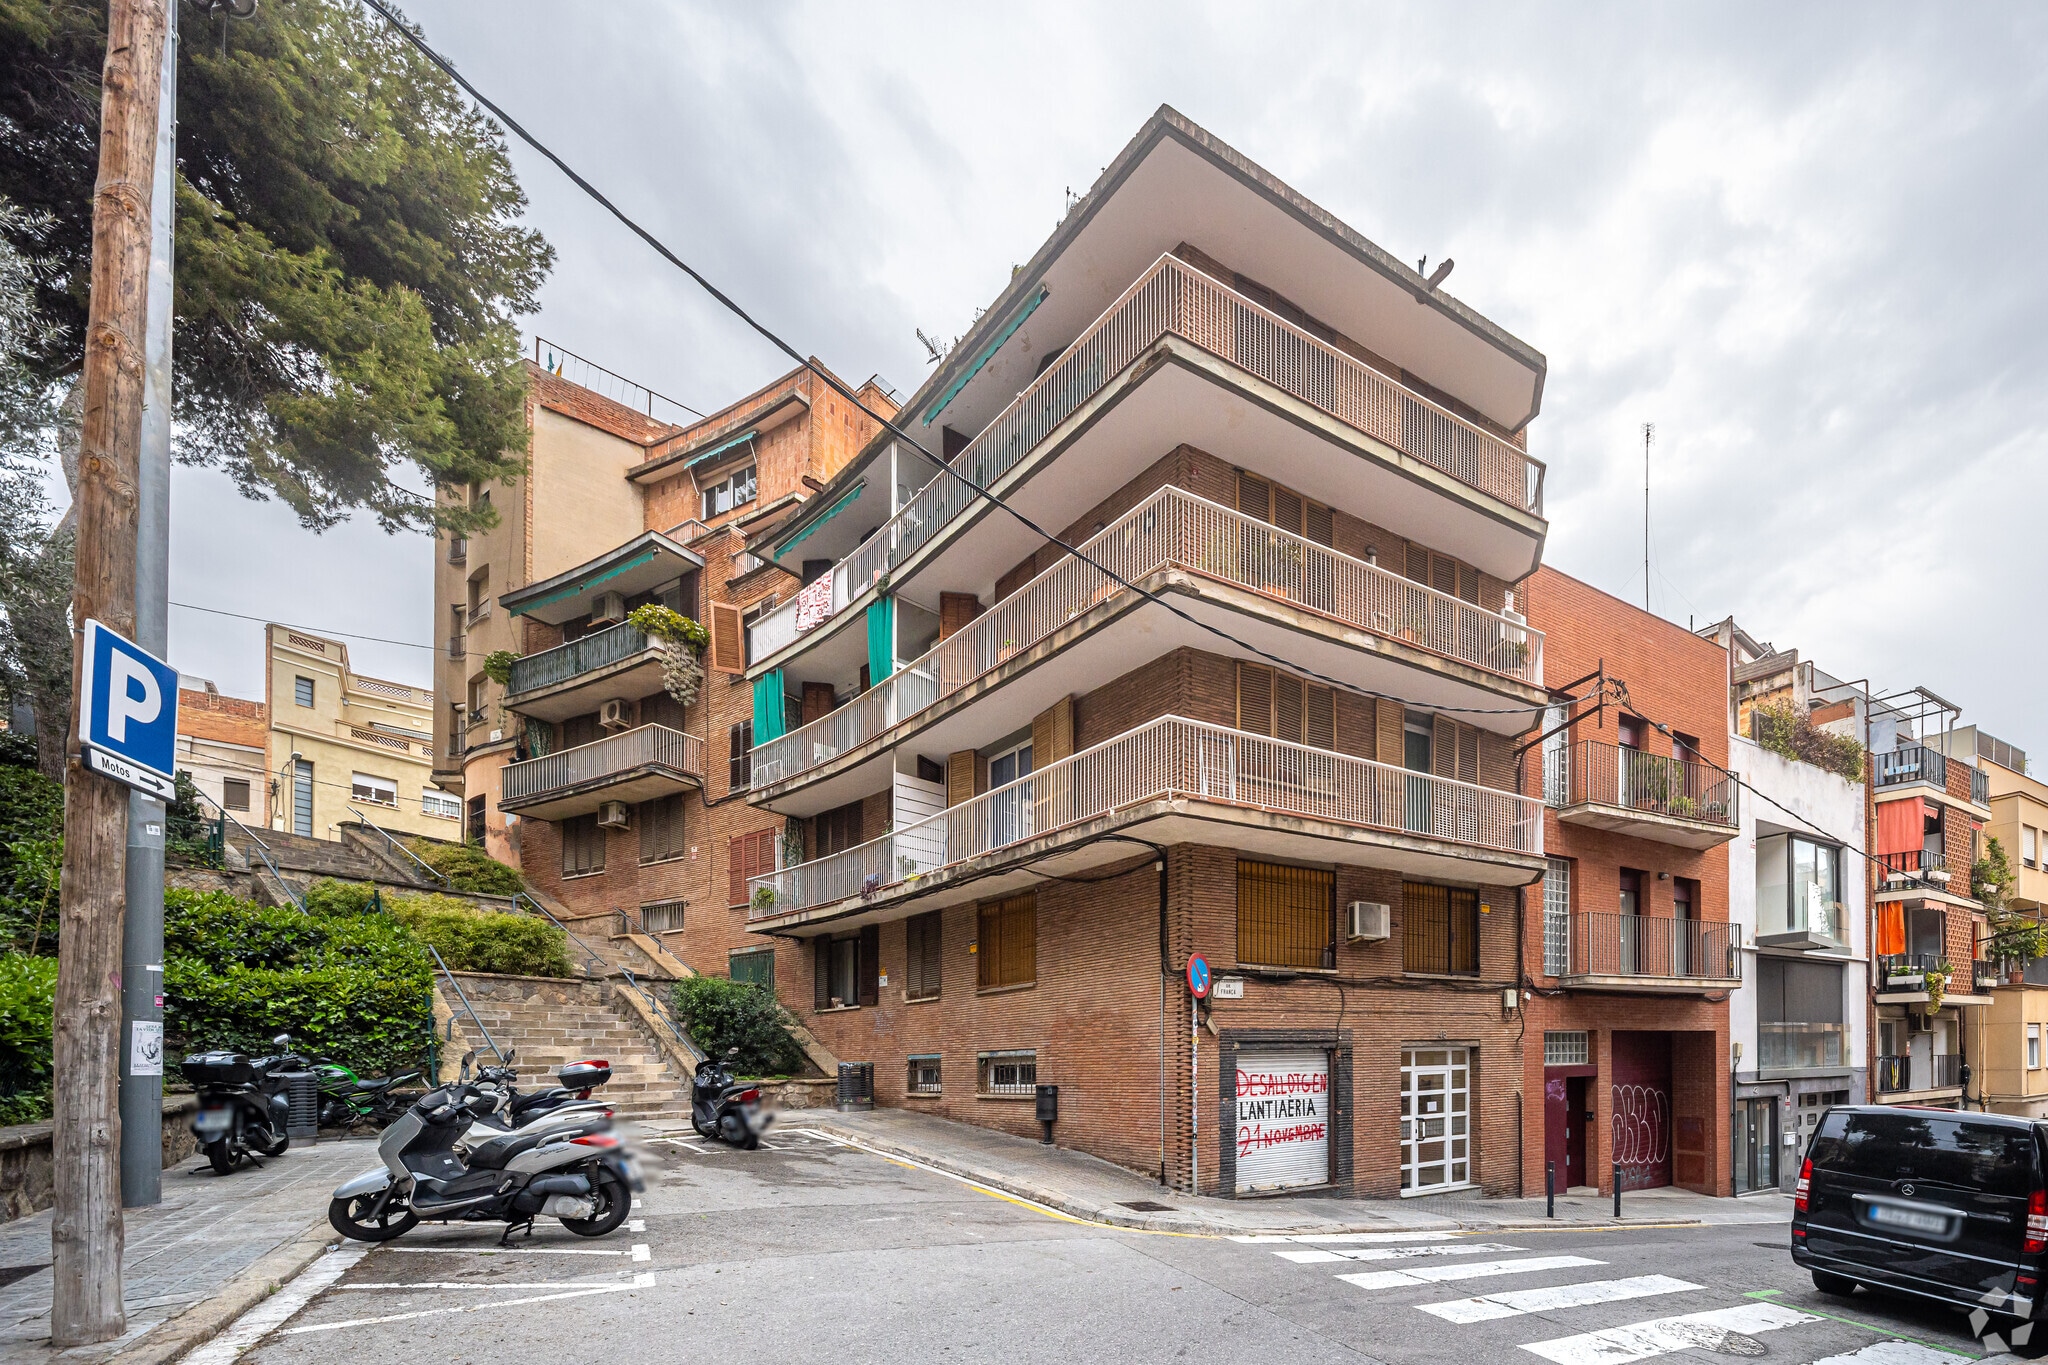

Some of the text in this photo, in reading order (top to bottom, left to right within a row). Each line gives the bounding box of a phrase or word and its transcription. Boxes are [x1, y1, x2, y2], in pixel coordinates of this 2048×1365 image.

[107, 647, 162, 743] P
[101, 756, 130, 778] Motos
[1235, 1069, 1327, 1096] DESALLOTGEN
[1240, 1095, 1316, 1120] L'ANTIAÈRIA
[1238, 1123, 1325, 1157] 21 NOVEMBRE
